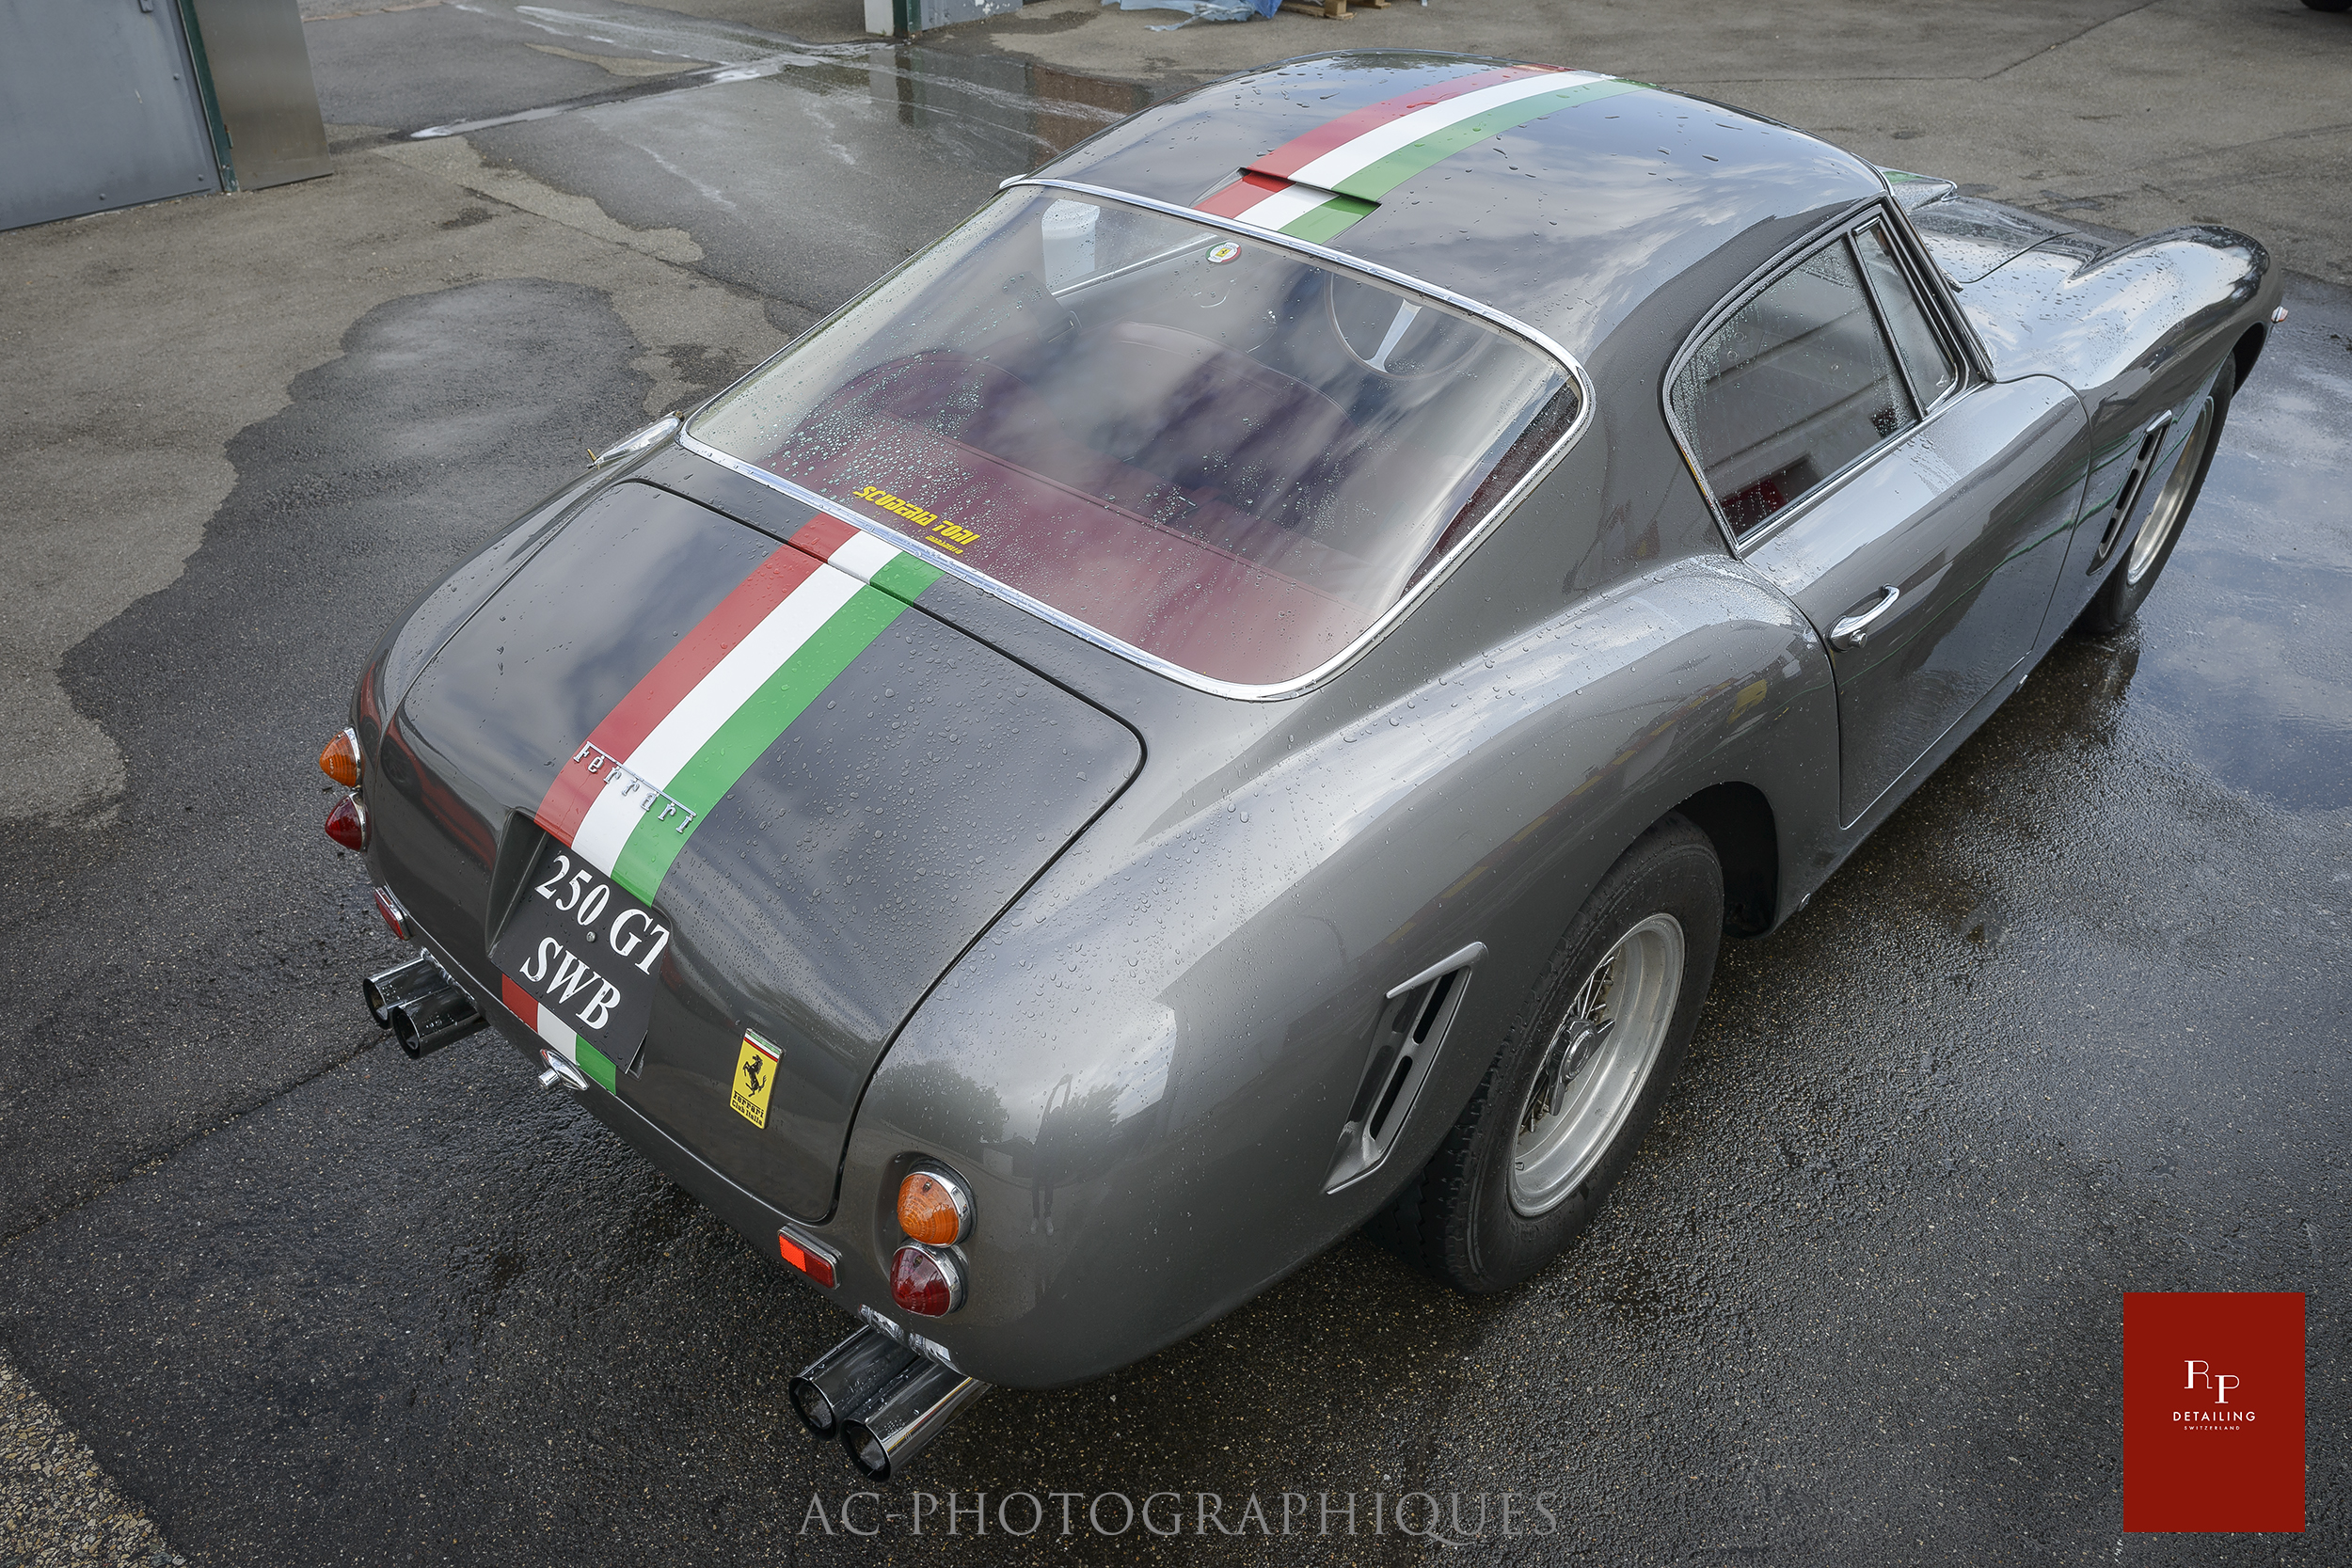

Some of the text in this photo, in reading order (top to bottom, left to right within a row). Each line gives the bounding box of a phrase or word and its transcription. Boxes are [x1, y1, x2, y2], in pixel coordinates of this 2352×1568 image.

[852, 485, 980, 546] SCUDERIA TONI
[573, 740, 697, 834] Ferrari
[534, 855, 611, 926] 250
[519, 937, 621, 1030] SWB
[732, 1100, 746, 1116] Club
[733, 1090, 765, 1118] Ferrari
